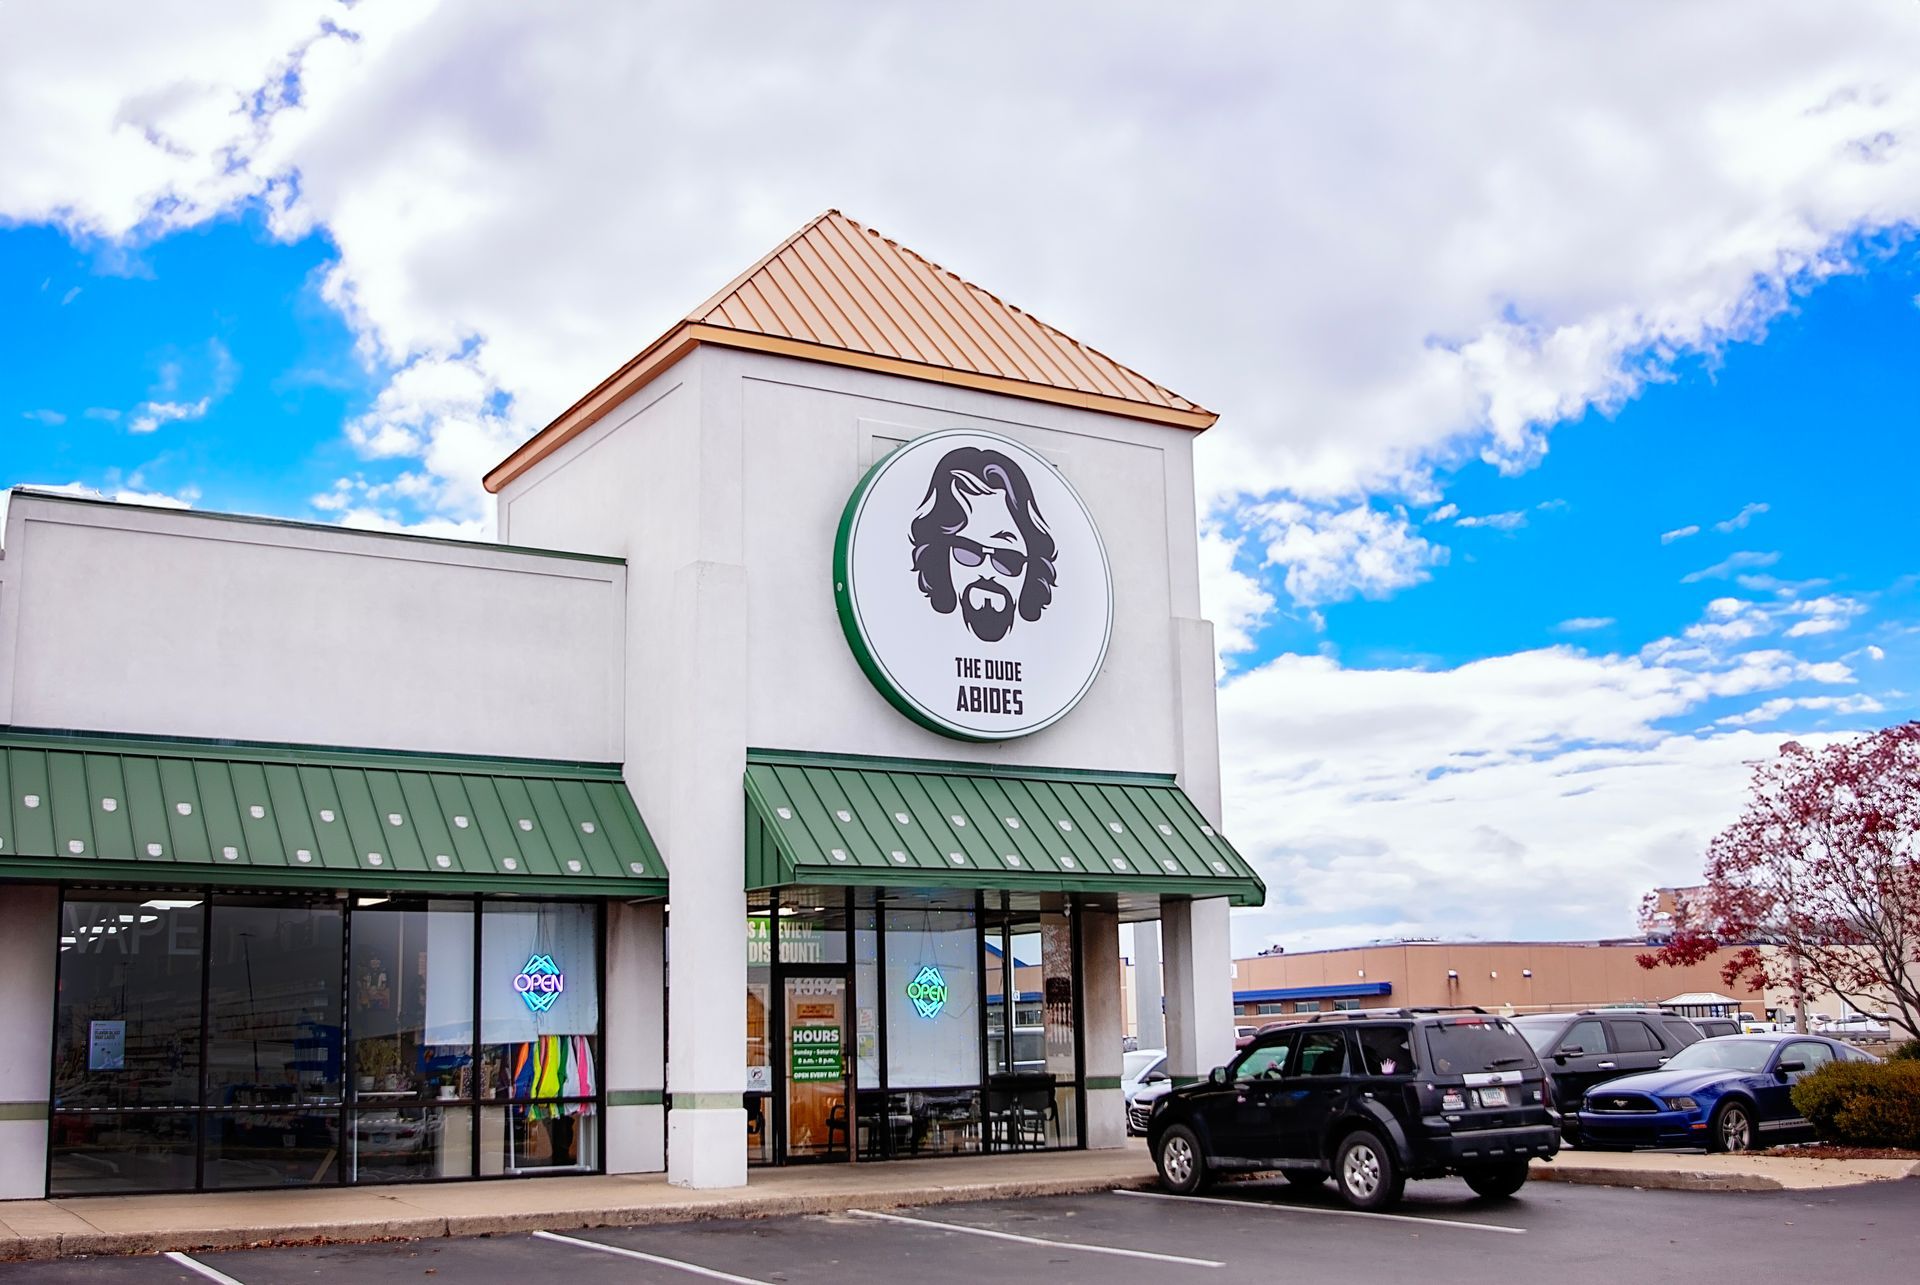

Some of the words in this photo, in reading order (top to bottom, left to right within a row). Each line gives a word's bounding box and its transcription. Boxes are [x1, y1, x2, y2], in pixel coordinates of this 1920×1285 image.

[955, 657, 982, 679] THE
[985, 659, 1022, 682] DUDE
[957, 685, 1023, 715] ABIDES
[65, 904, 201, 954] VAPE
[759, 921, 767, 938] A
[778, 921, 821, 939] EVIEW...
[748, 941, 820, 963] DISOUNT!
[513, 973, 564, 993] OPEN
[907, 982, 948, 1003] OPEN
[793, 1030, 839, 1043] HOURS
